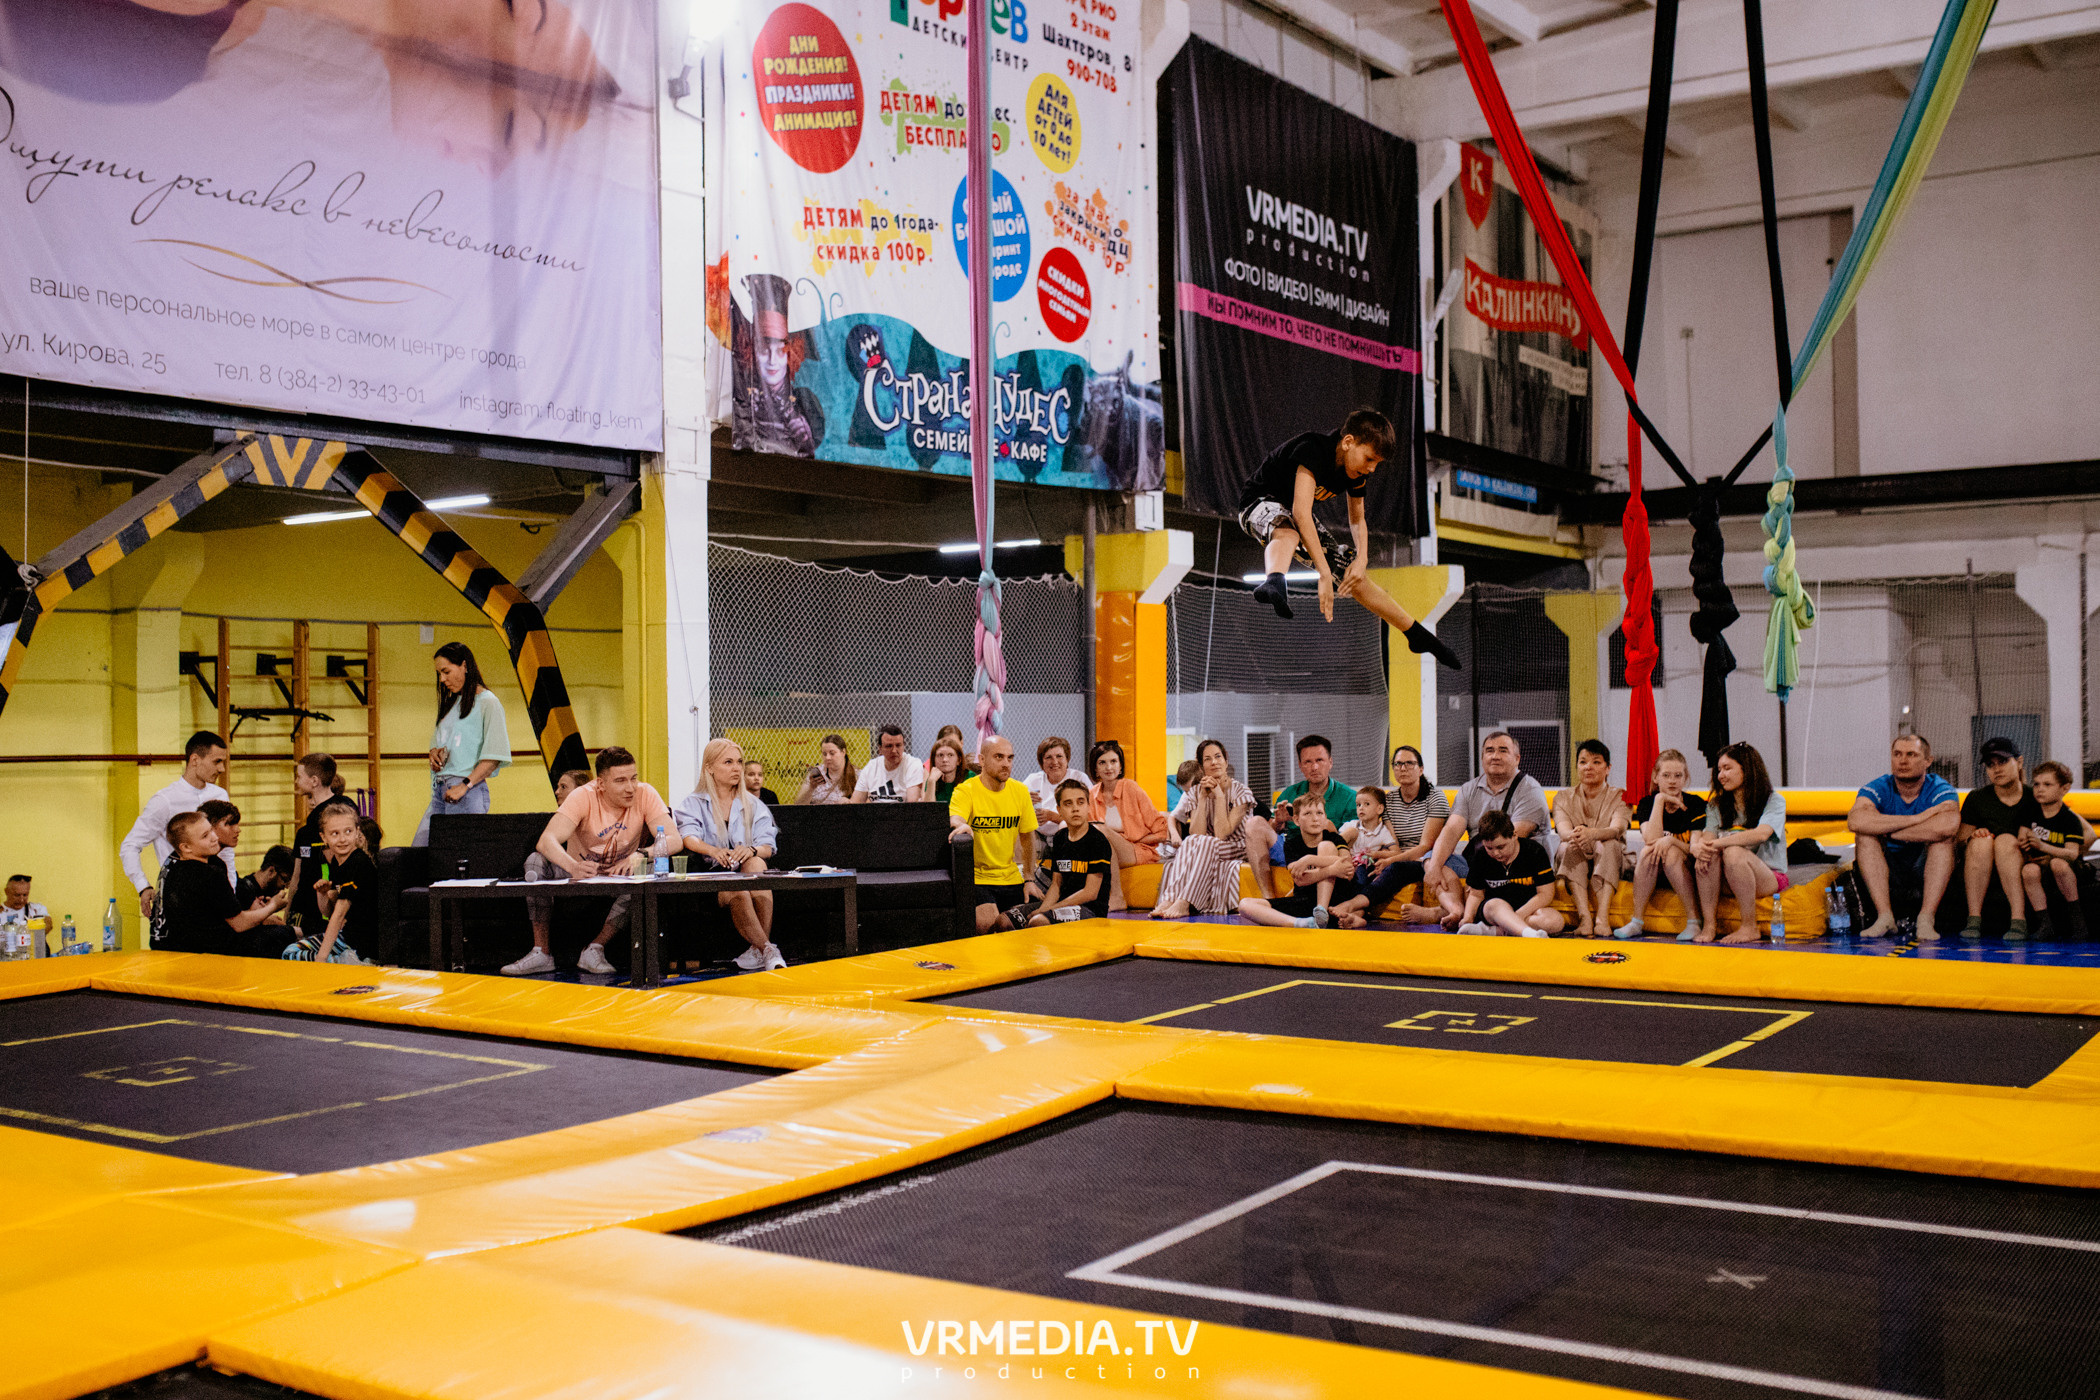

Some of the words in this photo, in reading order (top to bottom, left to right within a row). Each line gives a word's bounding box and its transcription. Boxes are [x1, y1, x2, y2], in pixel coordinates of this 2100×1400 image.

[1070, 12, 1079, 28] 2
[1082, 19, 1111, 42] этаж
[789, 35, 820, 55] ДНИ
[912, 16, 968, 49] ДЕТСКИ
[989, 48, 1029, 72] ЕНТР
[763, 56, 849, 77] РОЖДЕНИЯ!
[1124, 54, 1132, 72] 8
[764, 82, 856, 104] ПРАЗДНИКИ!
[880, 90, 939, 115] ДЕТЯМ
[944, 102, 965, 120] до
[1045, 84, 1069, 110] ДЛЯ
[773, 110, 858, 132] АНИМАЦИЯ!
[1037, 97, 1073, 132] ДЕТЕЙ
[904, 126, 1002, 151] БЕСПЛАО
[1034, 130, 1046, 147] 10
[130, 159, 310, 225] релакс
[323, 170, 352, 223] в
[361, 188, 585, 272] невесомости
[803, 206, 864, 231] ДЕТЯМ
[871, 216, 889, 231] до
[1245, 184, 1369, 262] VRMEDIA.TV
[1052, 214, 1096, 254] скидка
[816, 244, 881, 264] скидка
[1246, 227, 1370, 284] production
[1047, 265, 1085, 300] СКИДКИ
[30, 276, 90, 302] ваше
[96, 288, 256, 330] персональное
[262, 315, 315, 340] море
[320, 324, 331, 340] в
[336, 326, 396, 349] самом
[402, 337, 466, 362] центре
[471, 348, 527, 371] города
[1297, 325, 1323, 343] ЧЕГО
[1323, 331, 1337, 348] НЕ
[0, 331, 36, 353] ул.
[141, 352, 168, 375] 25
[214, 362, 253, 383] тел.
[259, 364, 272, 384] 8
[277, 366, 342, 393] (384-2)
[348, 379, 426, 404] 33-43-01
[547, 401, 643, 430] floating_kem
[913, 428, 999, 458] СЕМЕЙЕ
[1010, 440, 1048, 463] КАФЕ
